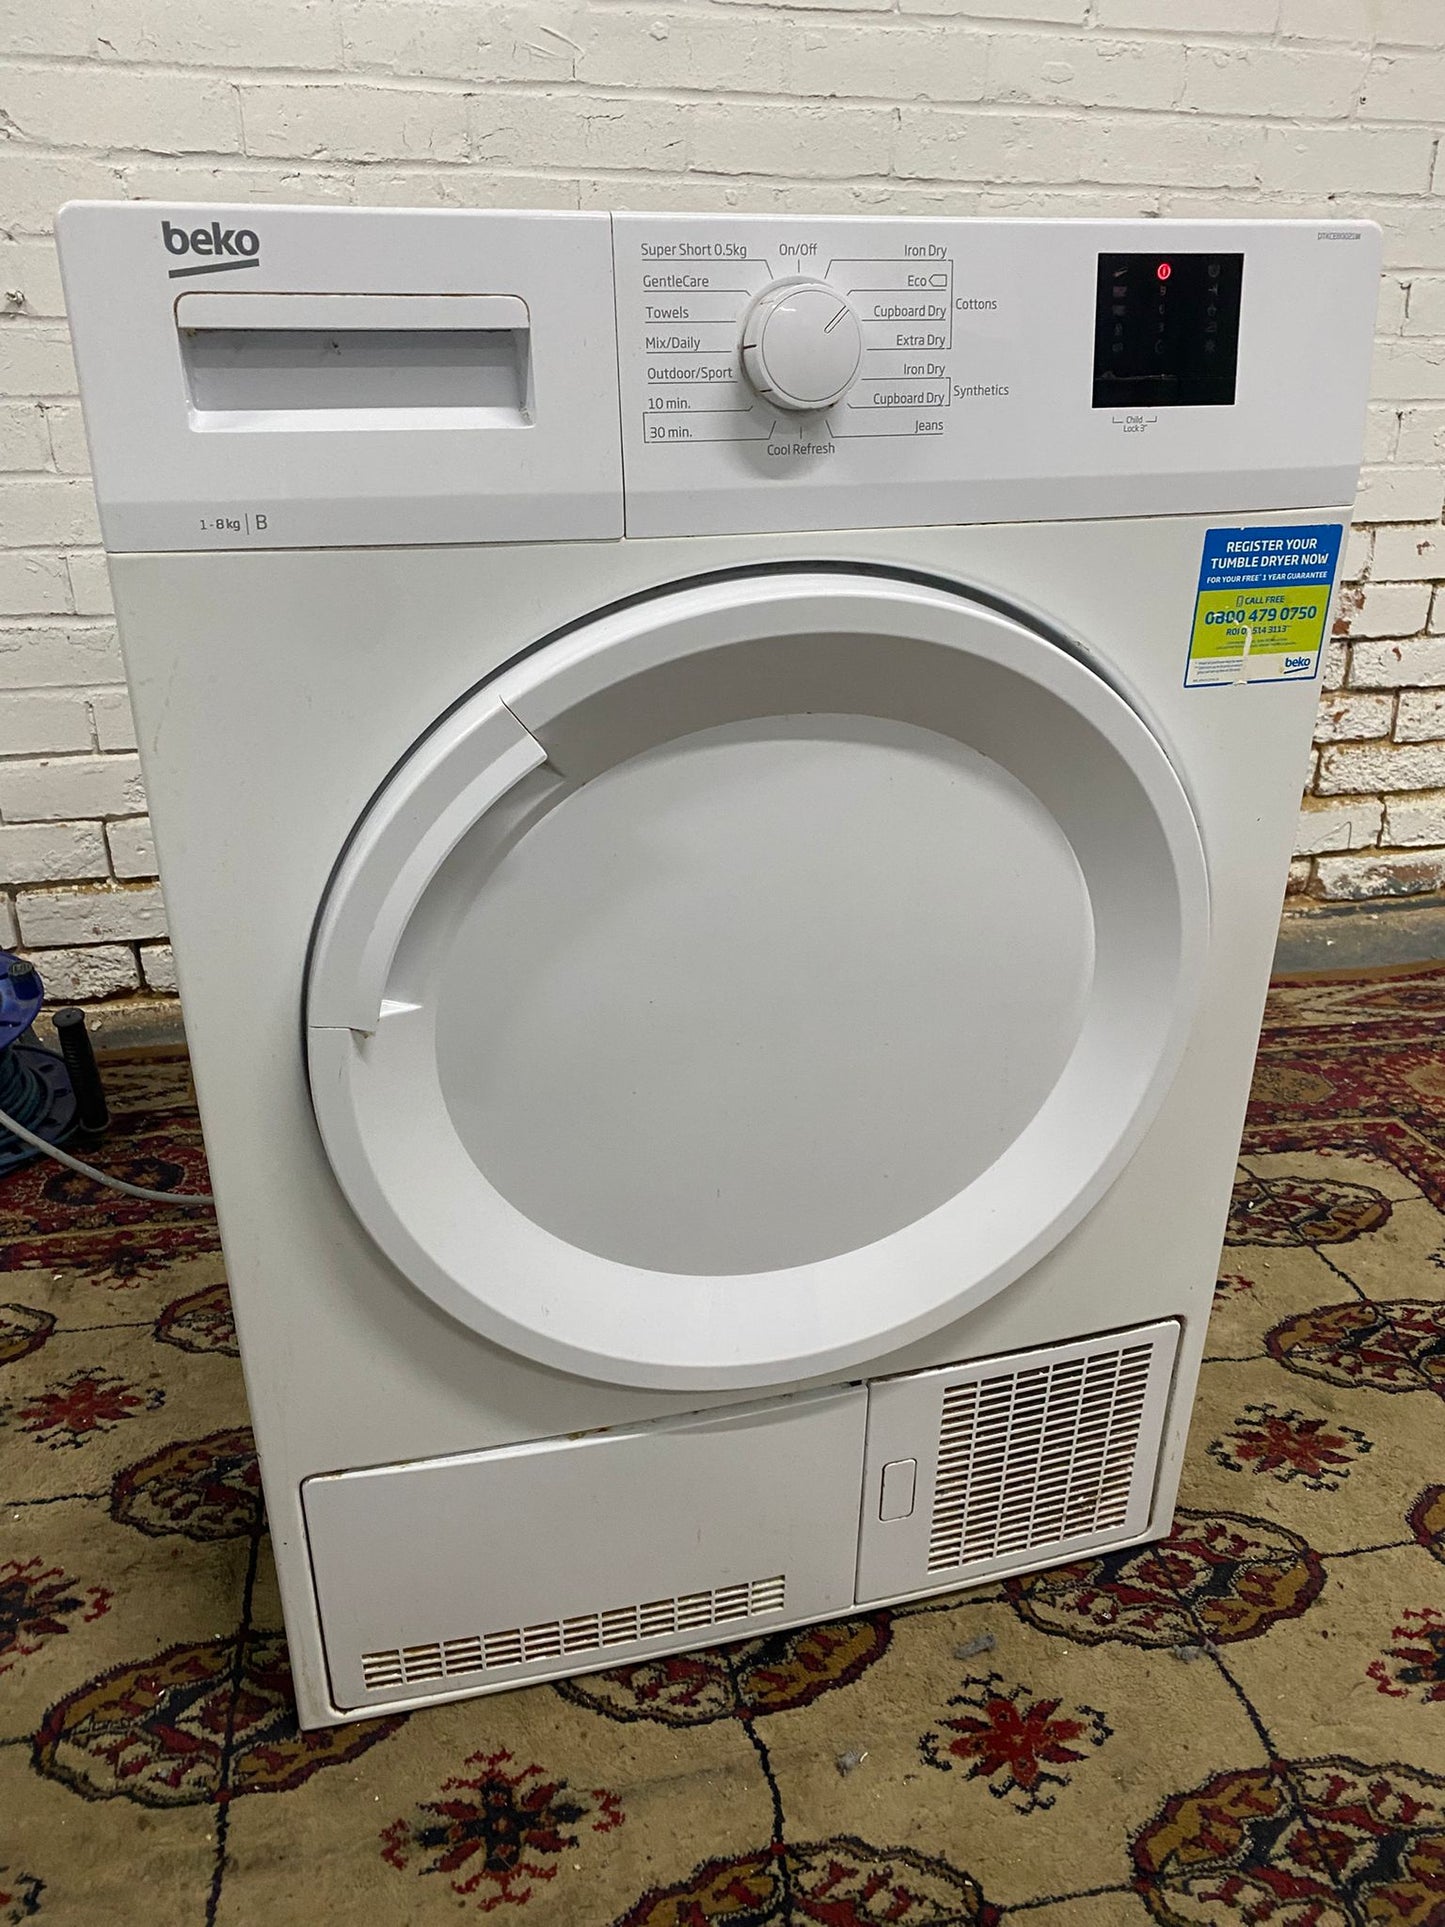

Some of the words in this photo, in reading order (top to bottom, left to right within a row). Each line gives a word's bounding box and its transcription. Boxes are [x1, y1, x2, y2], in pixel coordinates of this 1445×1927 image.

[162, 220, 260, 256] beko
[641, 243, 678, 258] Super
[678, 243, 712, 256] Short
[713, 243, 747, 259] 0.5kg
[778, 242, 818, 257] On/Off
[904, 244, 925, 257] Iron
[926, 244, 948, 259] Dry
[642, 274, 709, 288] GentleCare
[907, 275, 927, 287] Eco
[873, 304, 924, 319] Cupboard
[924, 304, 947, 319] Dry
[955, 297, 998, 311] Cottons
[645, 306, 690, 319] Towels
[645, 336, 701, 351] Mix/Daily
[896, 334, 923, 346] Extra
[923, 334, 946, 348] Dry
[647, 366, 733, 382] Outdoor/Sport
[903, 363, 924, 376] Iron
[924, 363, 946, 378] Dry
[873, 391, 923, 407] Cupboard
[923, 391, 946, 406] Dry
[953, 384, 1010, 400] Synthetics
[648, 397, 664, 410] 10
[667, 397, 692, 410] min.
[914, 419, 944, 434] Jeans
[1126, 415, 1144, 424] Child
[650, 427, 666, 439] 30
[668, 425, 693, 439] min.
[1123, 425, 1140, 433] Lock
[767, 443, 791, 456] Cool
[792, 442, 836, 456] Refresh
[255, 514, 268, 530] B
[1226, 540, 1284, 553] REGISTER
[1286, 538, 1318, 550] YOUR
[1211, 556, 1259, 569] TUMBLE
[1260, 554, 1299, 567] DRYER
[1300, 553, 1329, 565] NOW
[1206, 576, 1221, 584] FOR
[1222, 575, 1242, 583] YOUR
[1262, 573, 1267, 581] 1
[1268, 573, 1286, 581] YEAR
[1286, 570, 1328, 580] GUARANTEE
[1245, 597, 1264, 605] CALL
[1265, 595, 1286, 604] FREE
[1205, 610, 1246, 625] 0800
[1248, 608, 1278, 622] 479
[1280, 605, 1318, 620] 0750
[1252, 626, 1267, 635] 514
[1285, 657, 1311, 668] beko
